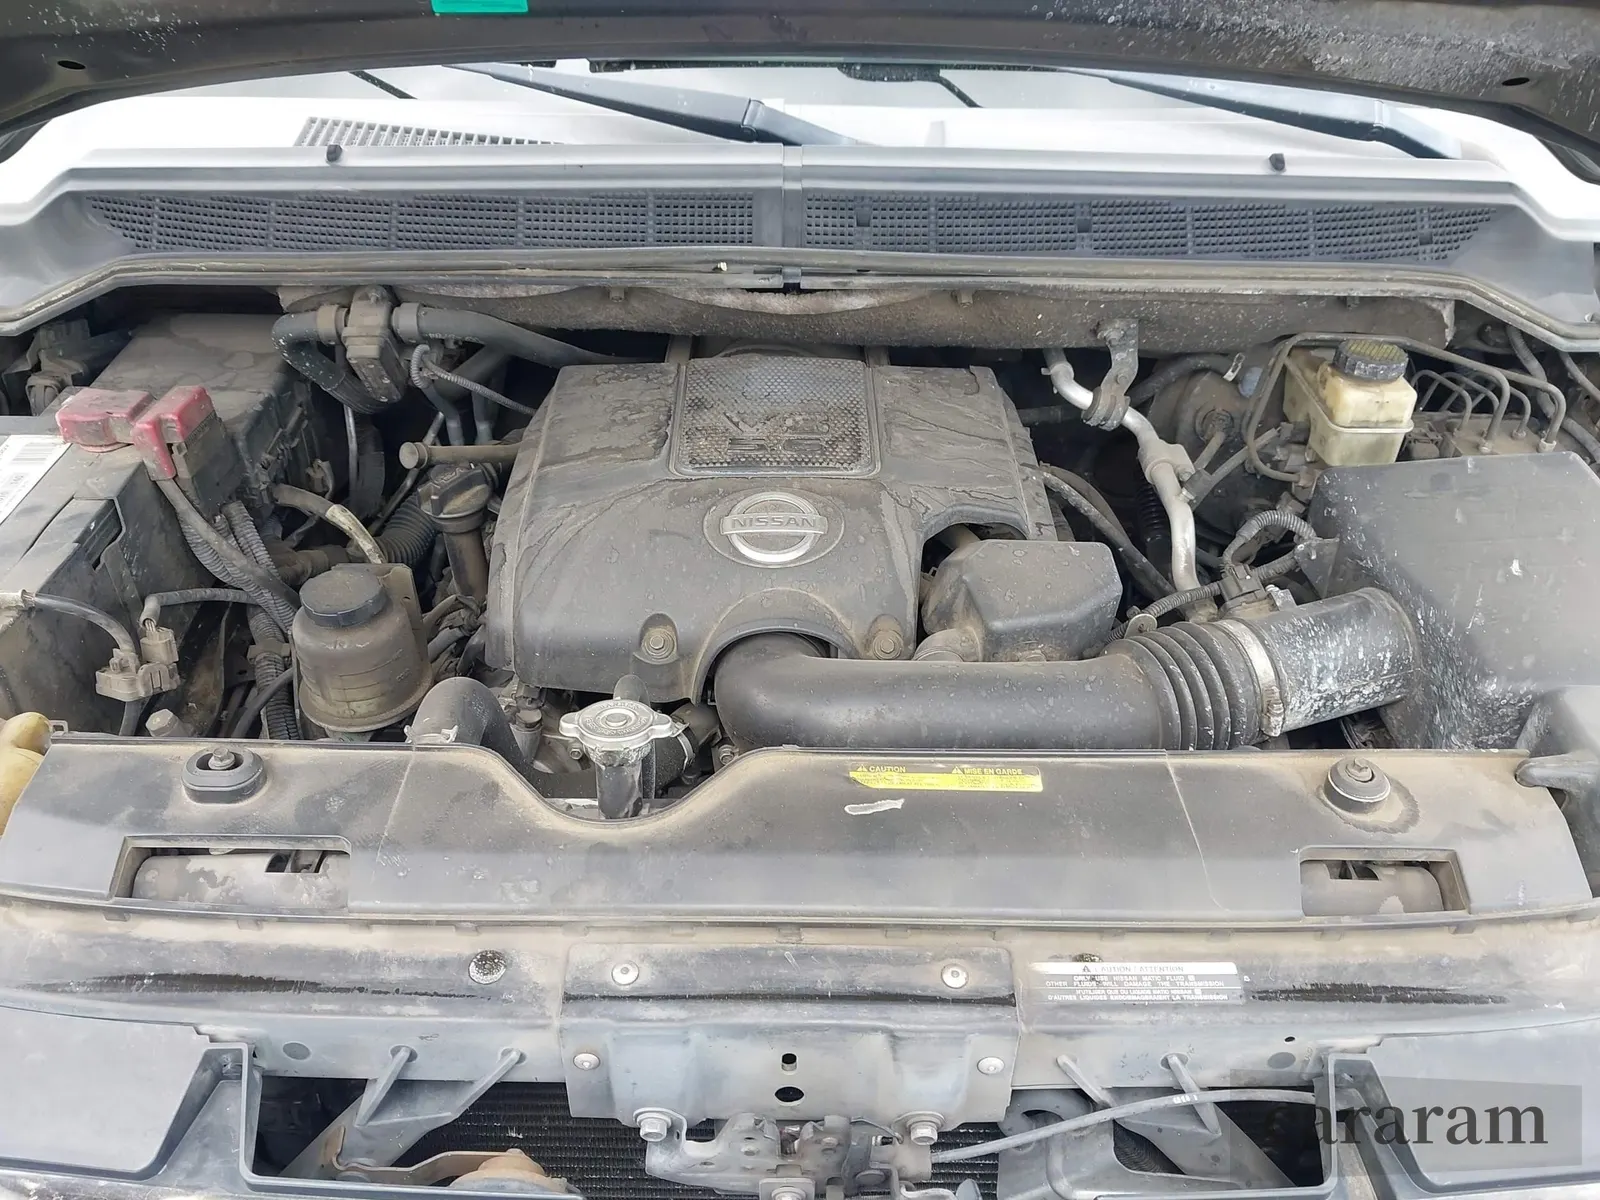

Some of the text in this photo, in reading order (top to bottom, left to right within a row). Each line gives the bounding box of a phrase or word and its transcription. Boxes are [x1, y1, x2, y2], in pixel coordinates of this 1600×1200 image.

[731, 515, 816, 529] NISSAN
[868, 765, 906, 773] CAUTION
[964, 767, 1023, 776] MISE EN GARDE
[1139, 965, 1184, 973] ATTENTION
